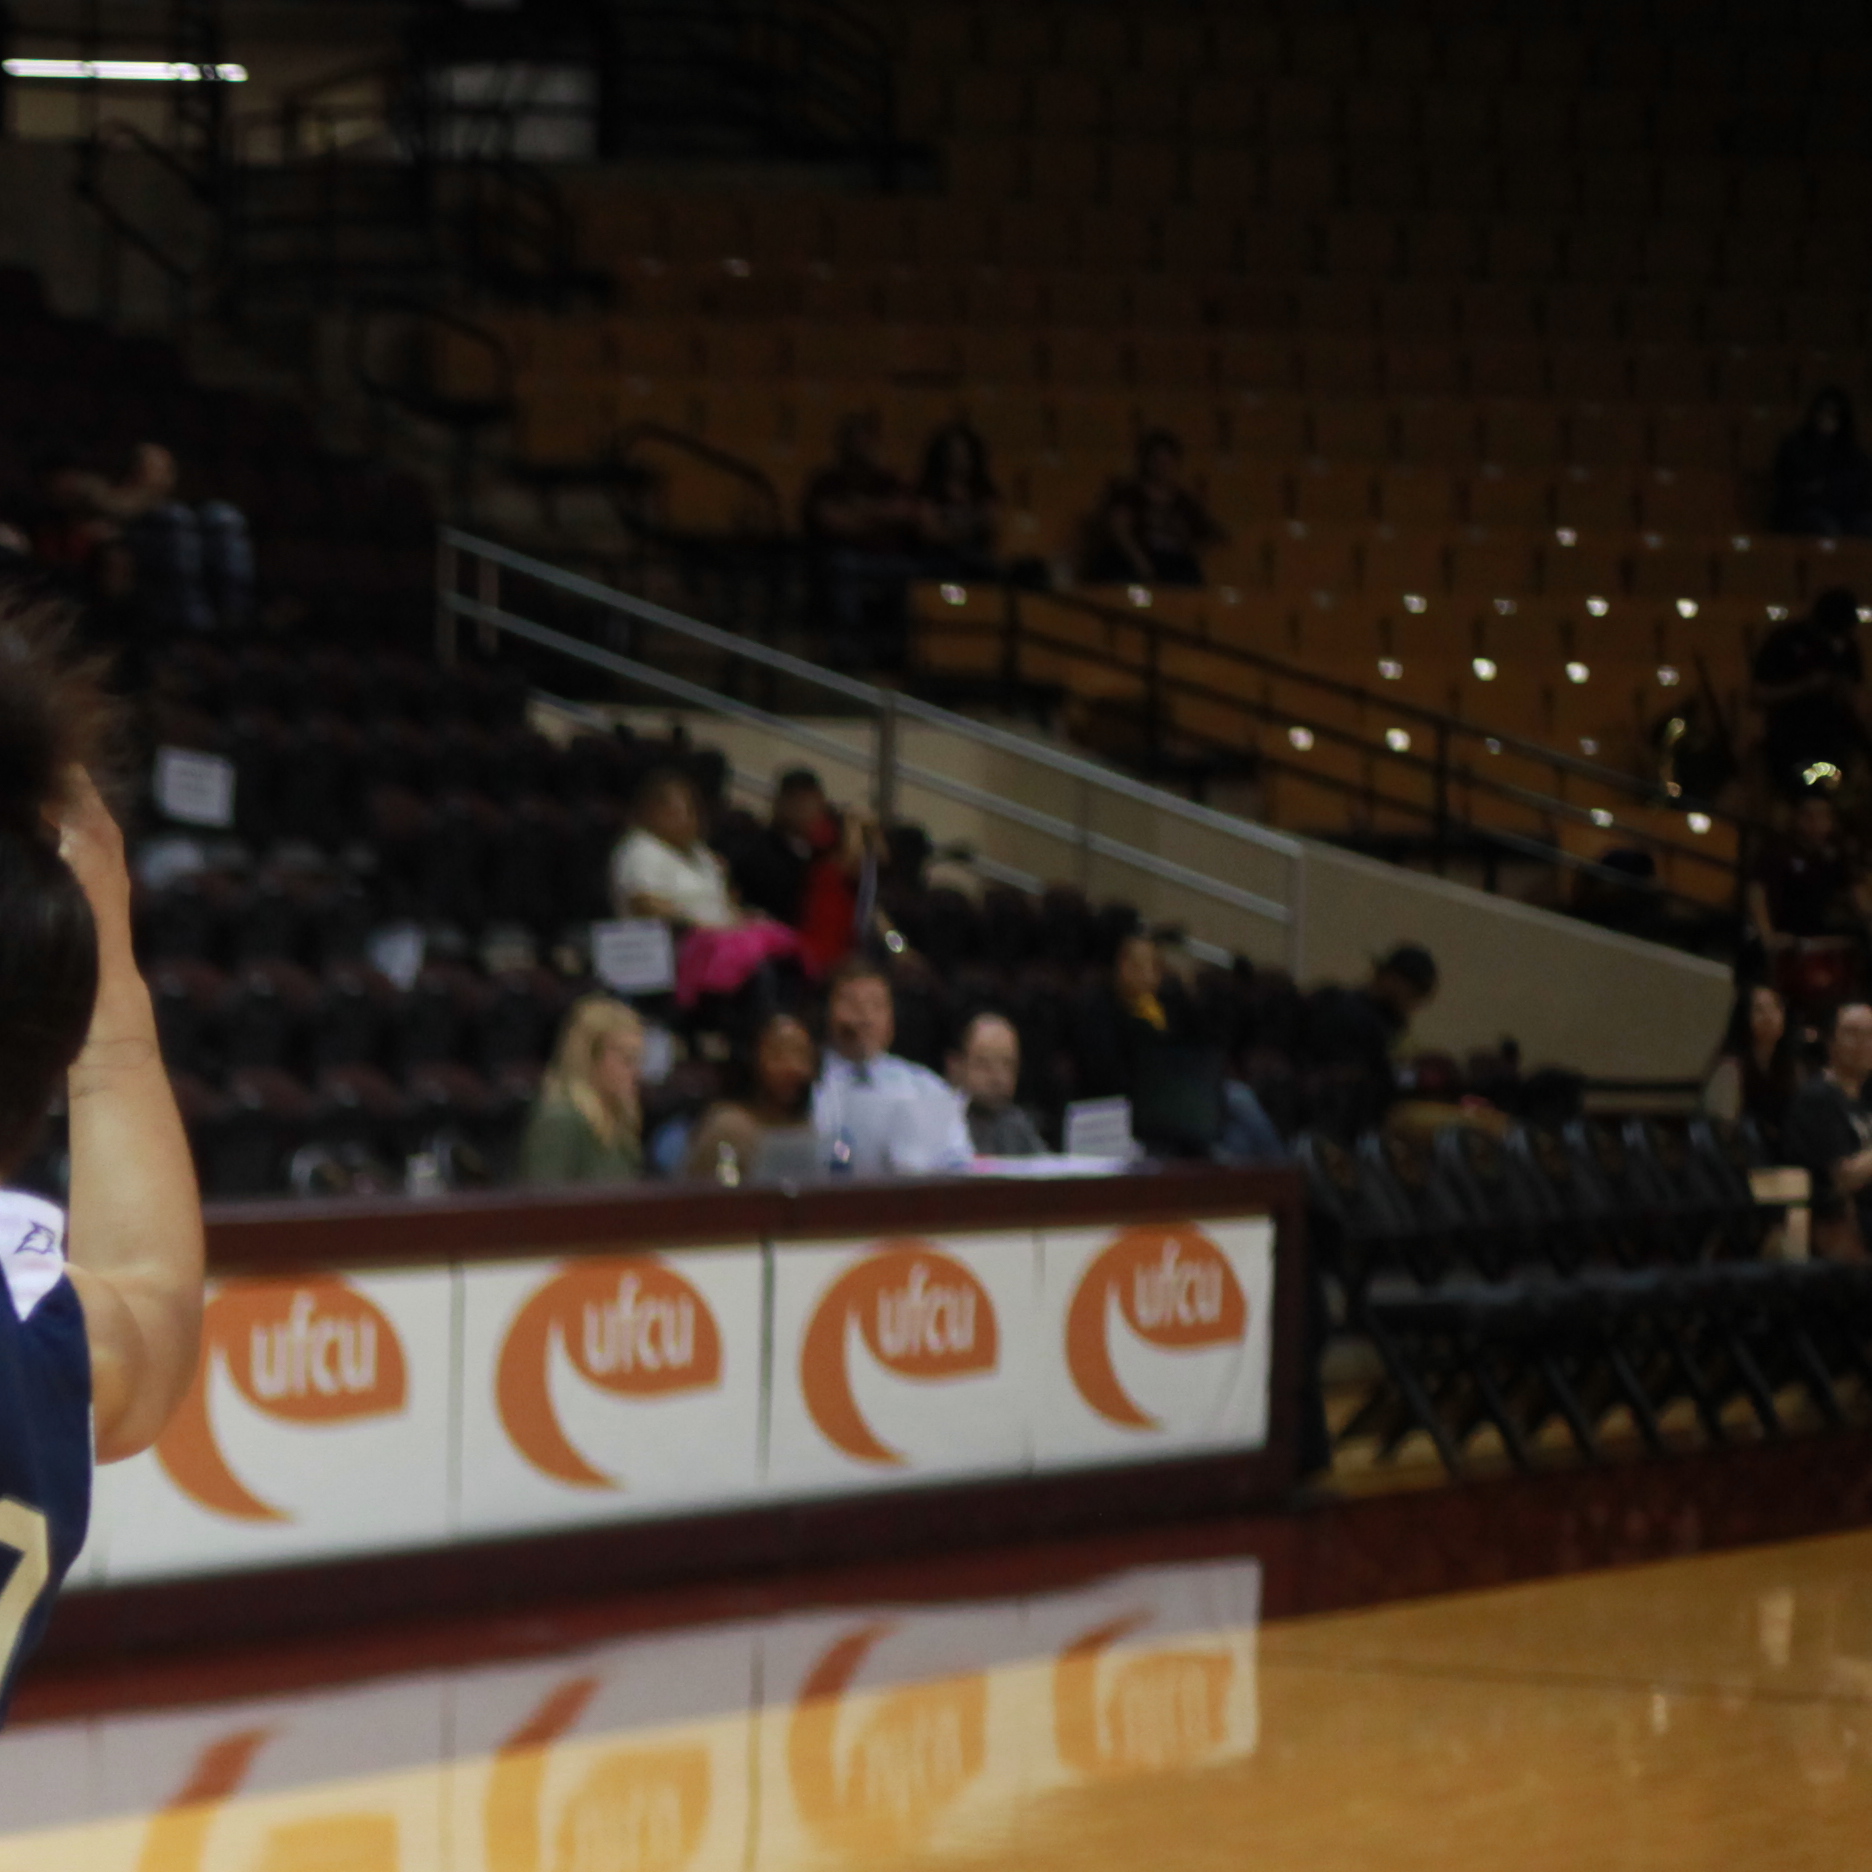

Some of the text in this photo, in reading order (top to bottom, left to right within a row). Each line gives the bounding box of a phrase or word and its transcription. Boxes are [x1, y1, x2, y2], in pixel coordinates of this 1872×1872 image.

[582, 1271, 697, 1377] ufcu
[876, 1262, 977, 1360] ufcu
[1132, 1239, 1223, 1327] ufcu
[248, 1293, 377, 1400] ufcu
